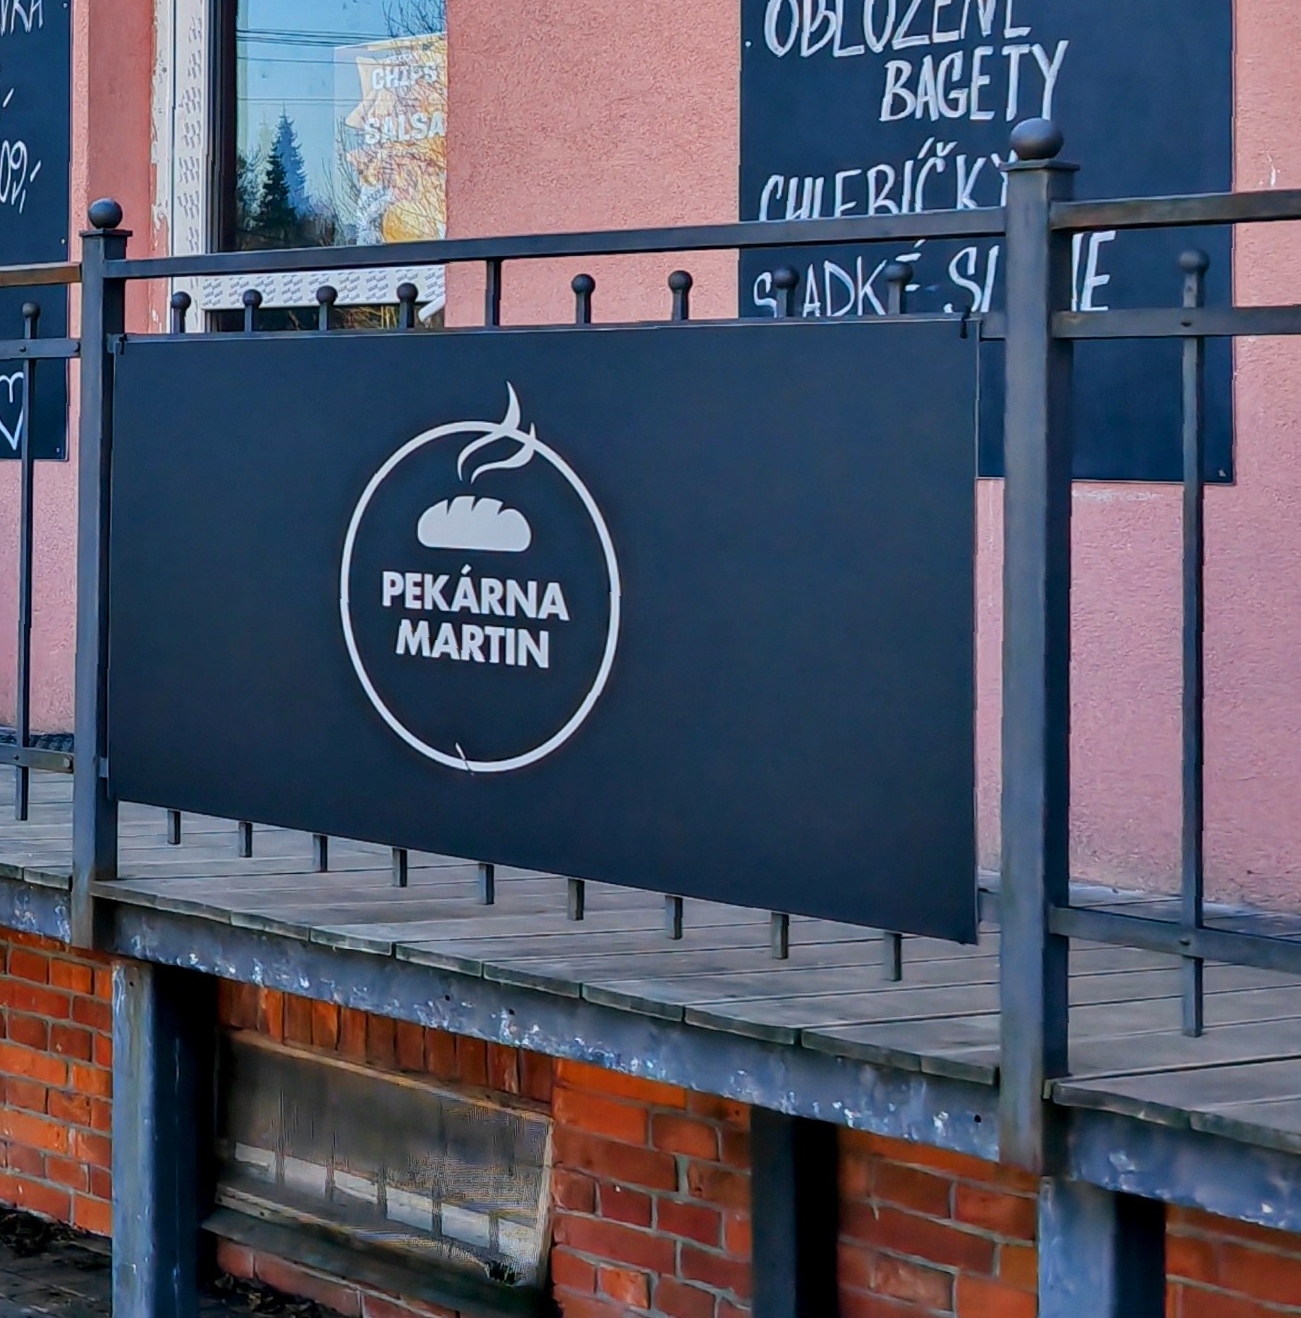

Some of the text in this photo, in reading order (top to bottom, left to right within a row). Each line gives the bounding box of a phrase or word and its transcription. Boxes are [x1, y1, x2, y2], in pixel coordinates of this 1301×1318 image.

[879, 39, 1070, 123] BAGETY
[364, 111, 446, 145] SALSA
[381, 563, 571, 622] PEKÁRNA
[395, 617, 550, 670] MARTIN
